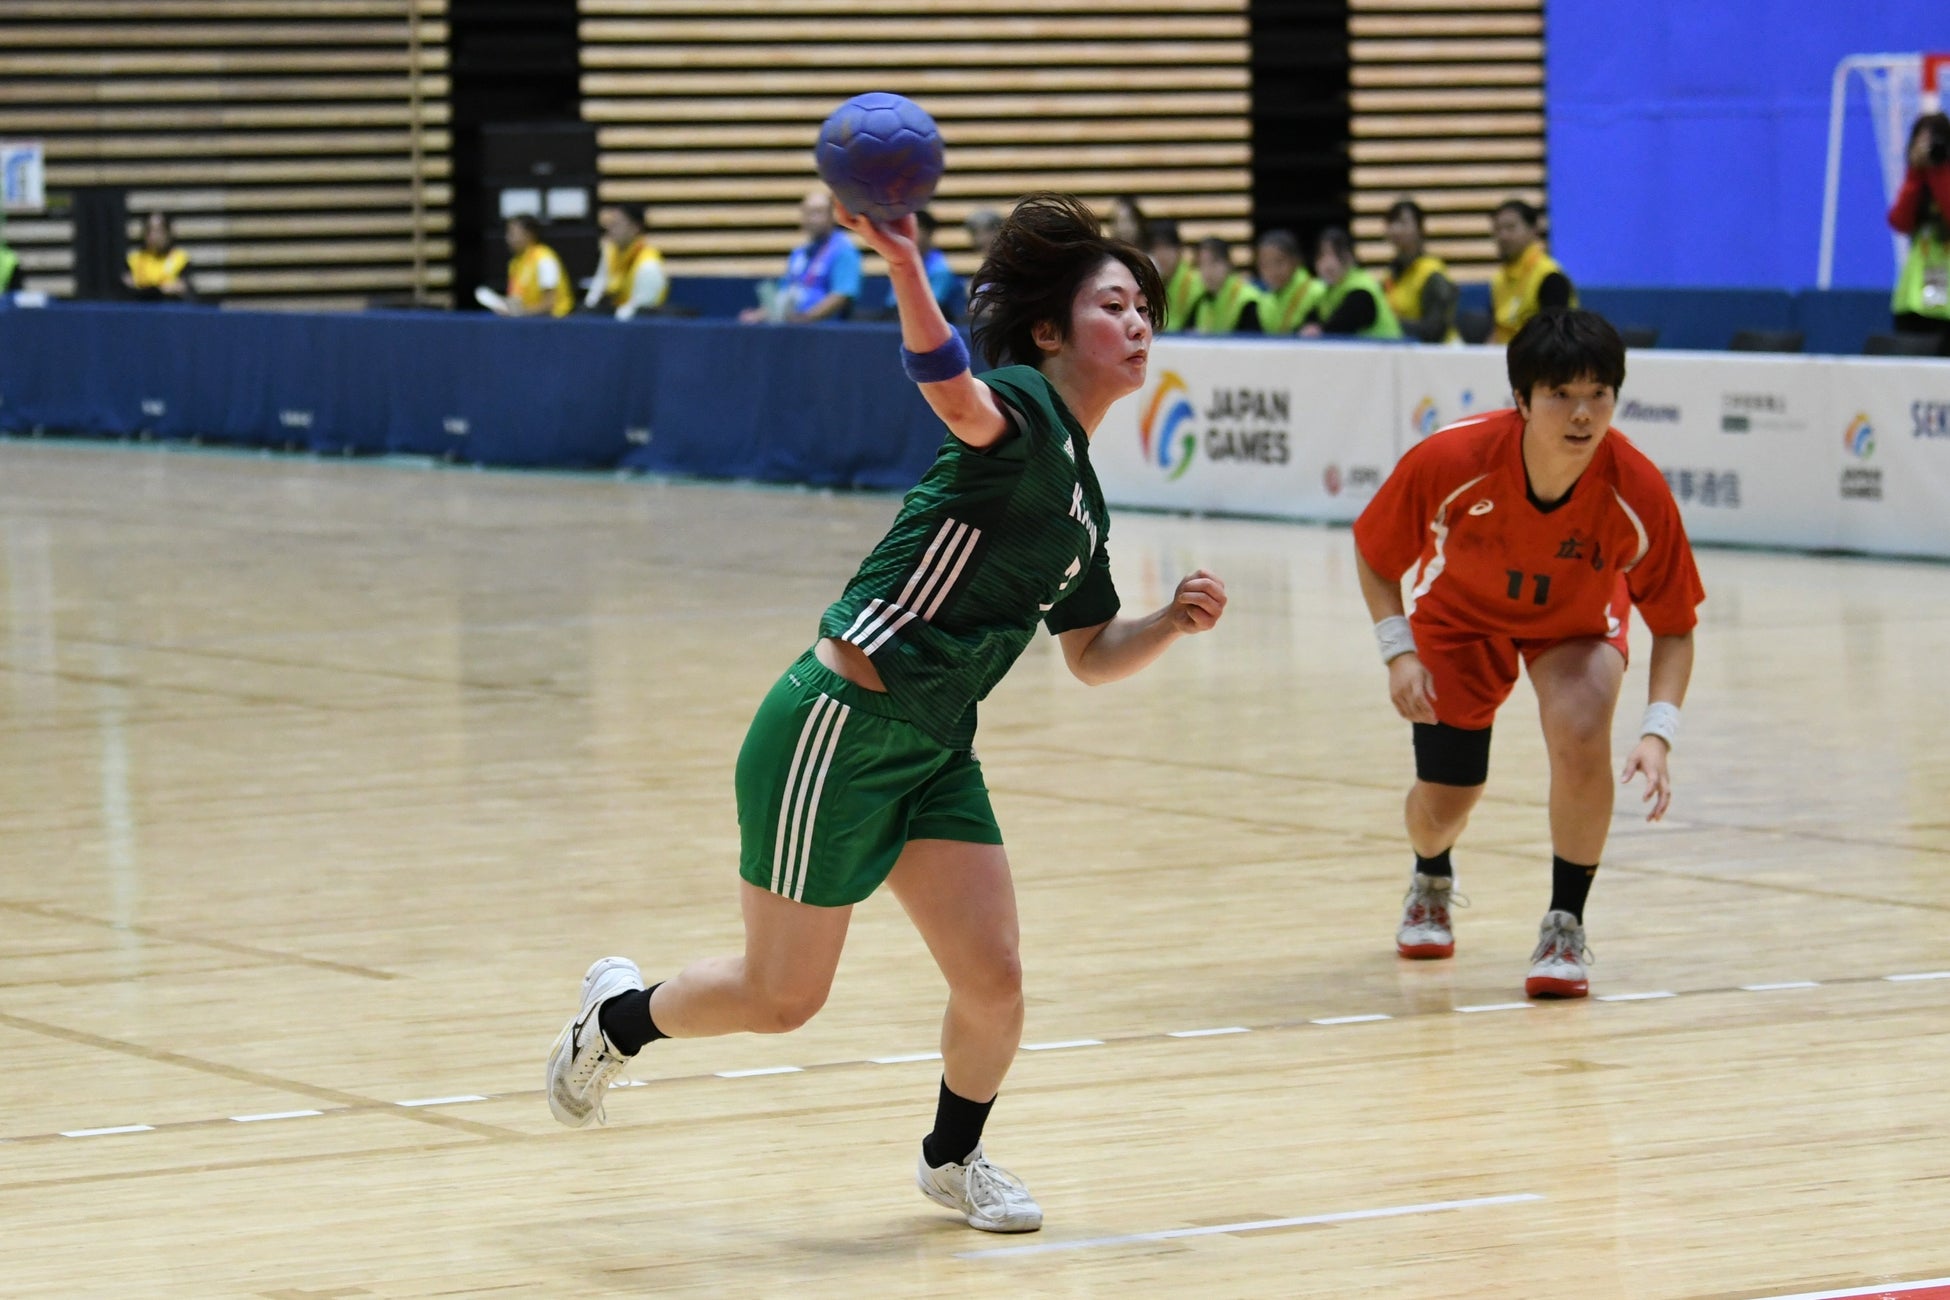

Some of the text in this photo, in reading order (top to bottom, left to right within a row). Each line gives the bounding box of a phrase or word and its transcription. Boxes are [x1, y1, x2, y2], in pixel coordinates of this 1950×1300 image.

[1205, 387, 1291, 422] JAPAN
[1204, 428, 1291, 466] GAMES
[1506, 570, 1551, 606] 11
